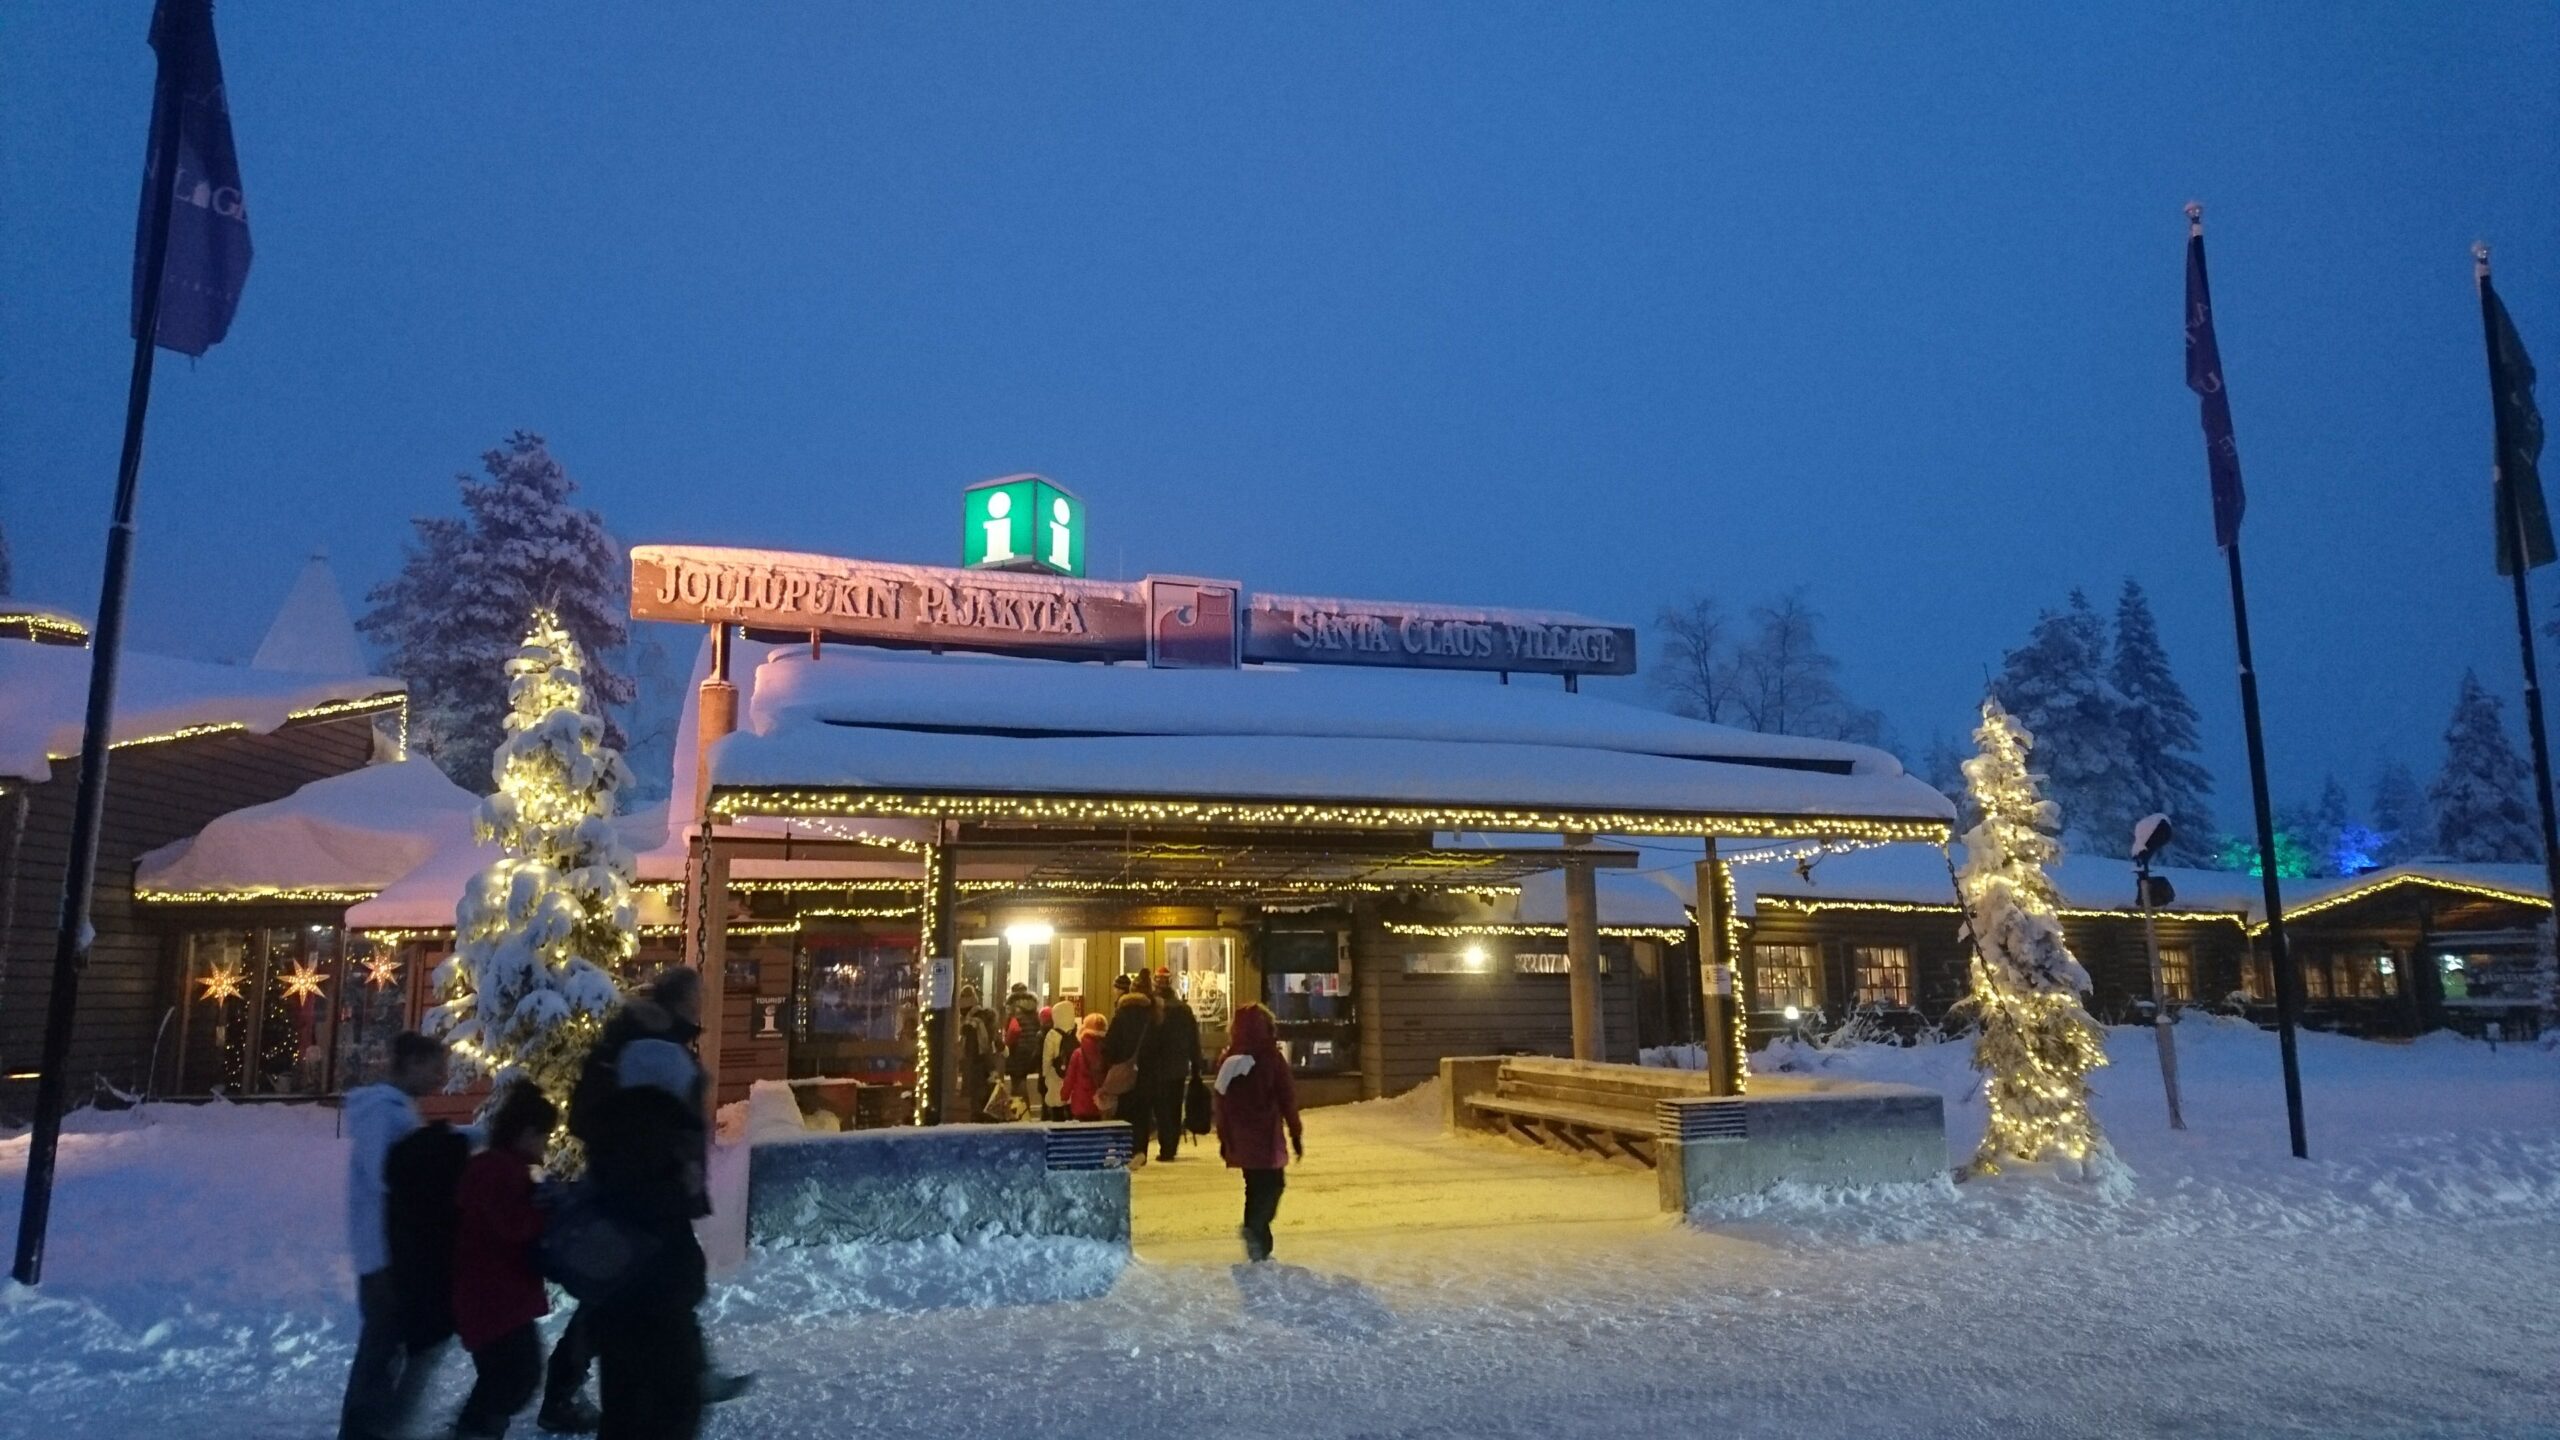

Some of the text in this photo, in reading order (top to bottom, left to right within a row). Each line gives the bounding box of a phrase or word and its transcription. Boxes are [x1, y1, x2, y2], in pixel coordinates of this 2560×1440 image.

[1292, 607, 1615, 663] SANTA CLAUS VILLAGE
[755, 996, 786, 1004] TOURIST
